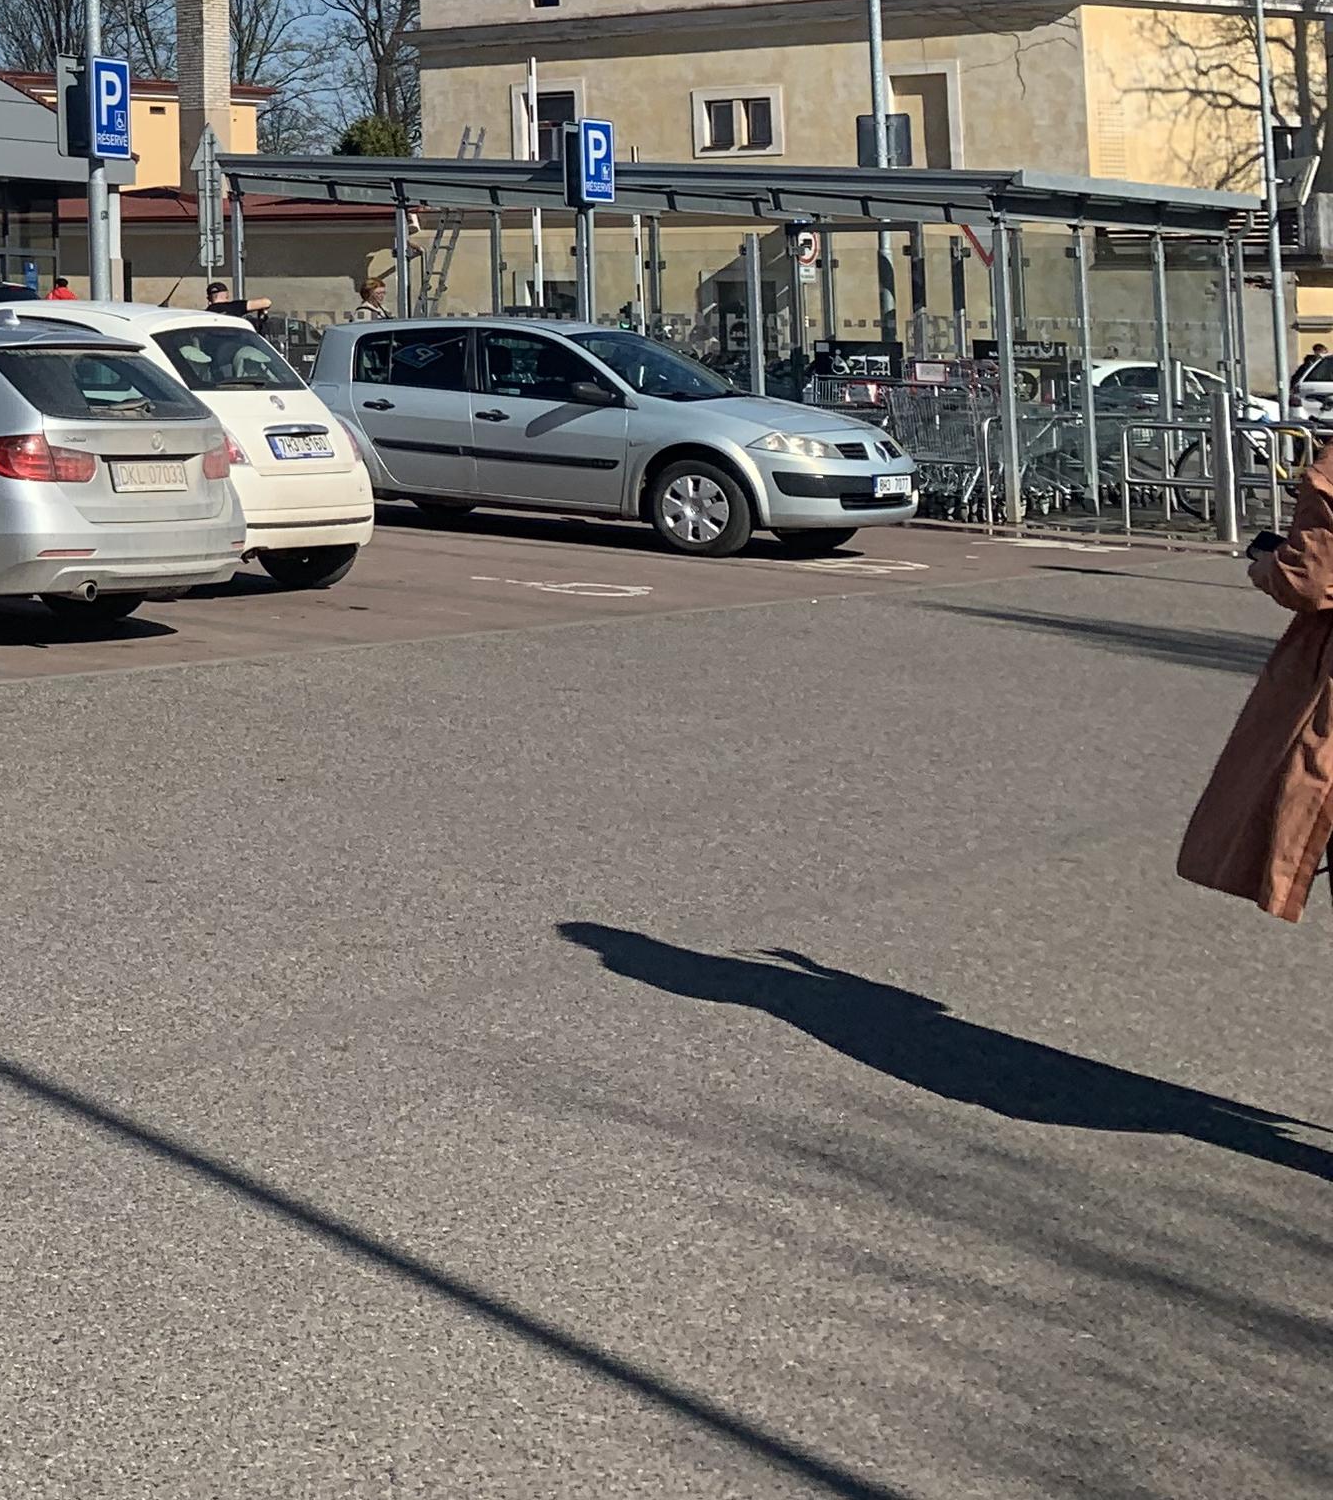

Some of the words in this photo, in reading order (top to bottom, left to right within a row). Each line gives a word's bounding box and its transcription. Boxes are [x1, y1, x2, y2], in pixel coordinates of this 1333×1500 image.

[100, 70, 122, 126] P
[96, 130, 128, 147] RÉSERVÉ
[588, 129, 607, 175] P
[585, 180, 613, 193] RÉSERVÉ
[120, 465, 145, 485] DKL
[150, 465, 184, 485] 07033
